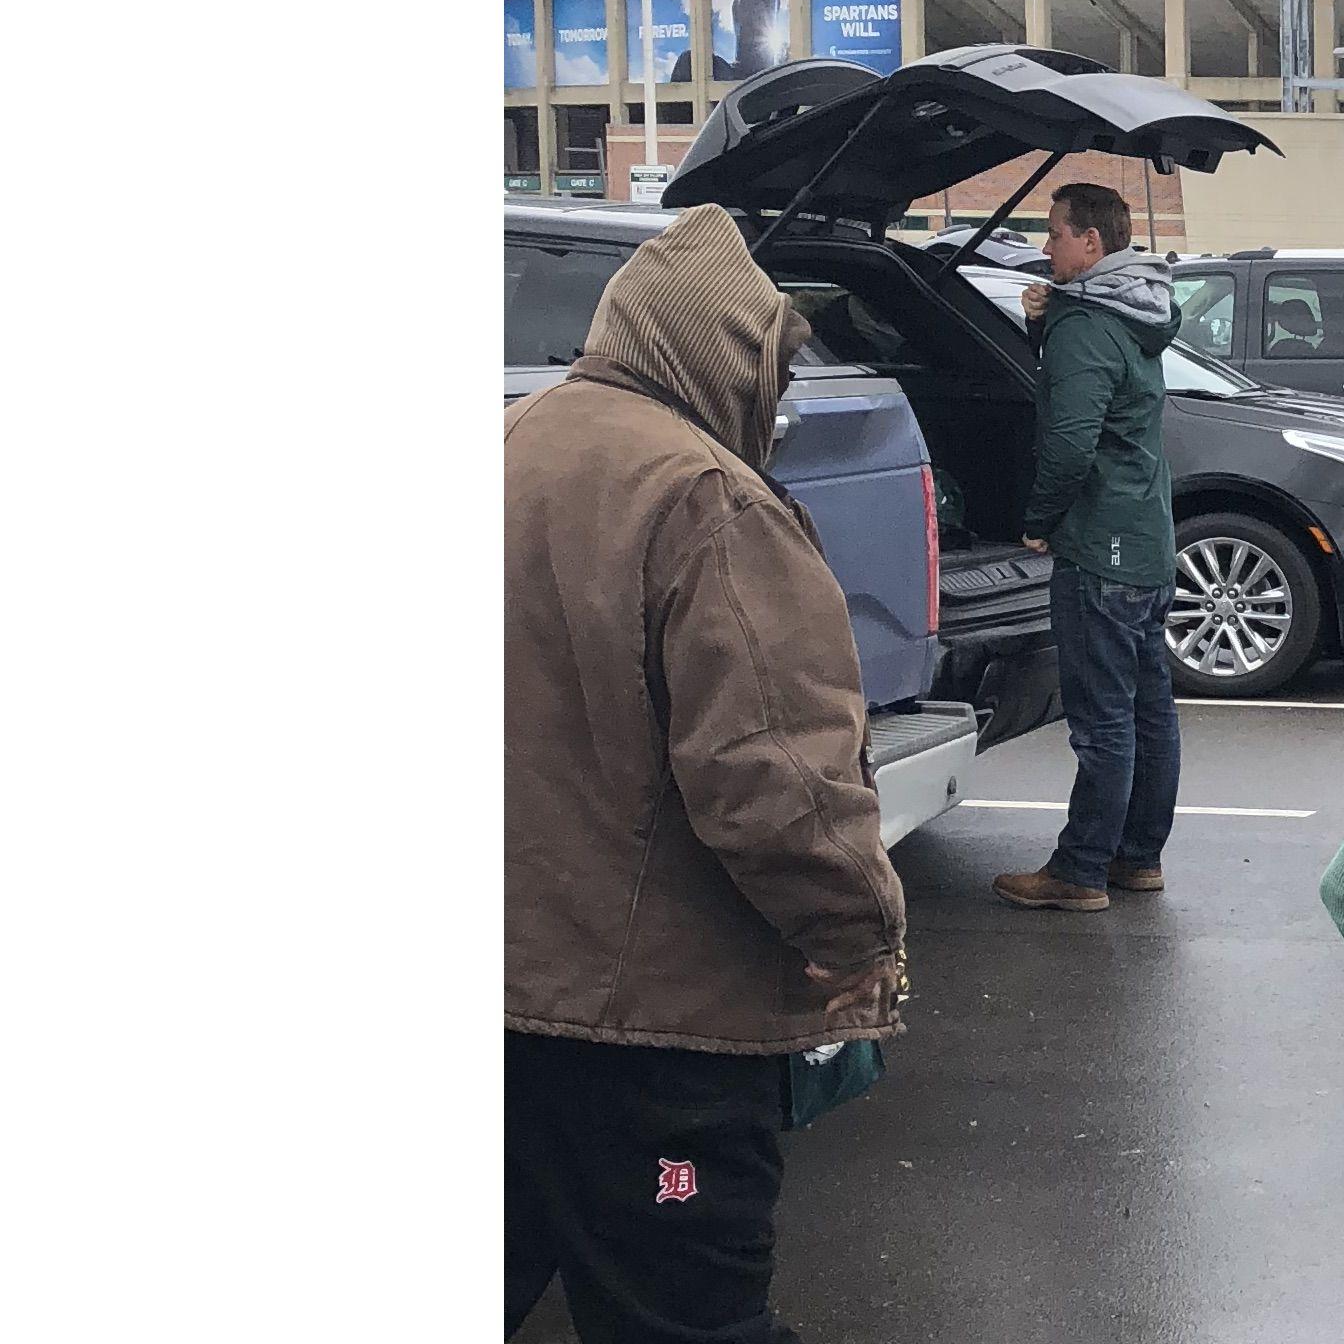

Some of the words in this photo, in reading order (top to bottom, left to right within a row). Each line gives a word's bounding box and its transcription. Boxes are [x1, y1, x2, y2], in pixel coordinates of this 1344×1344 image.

[823, 4, 899, 22] SPARTANS
[638, 23, 689, 39] FREVER.
[570, 178, 587, 187] GATE
[588, 178, 595, 187] C
[656, 1157, 699, 1204] D
